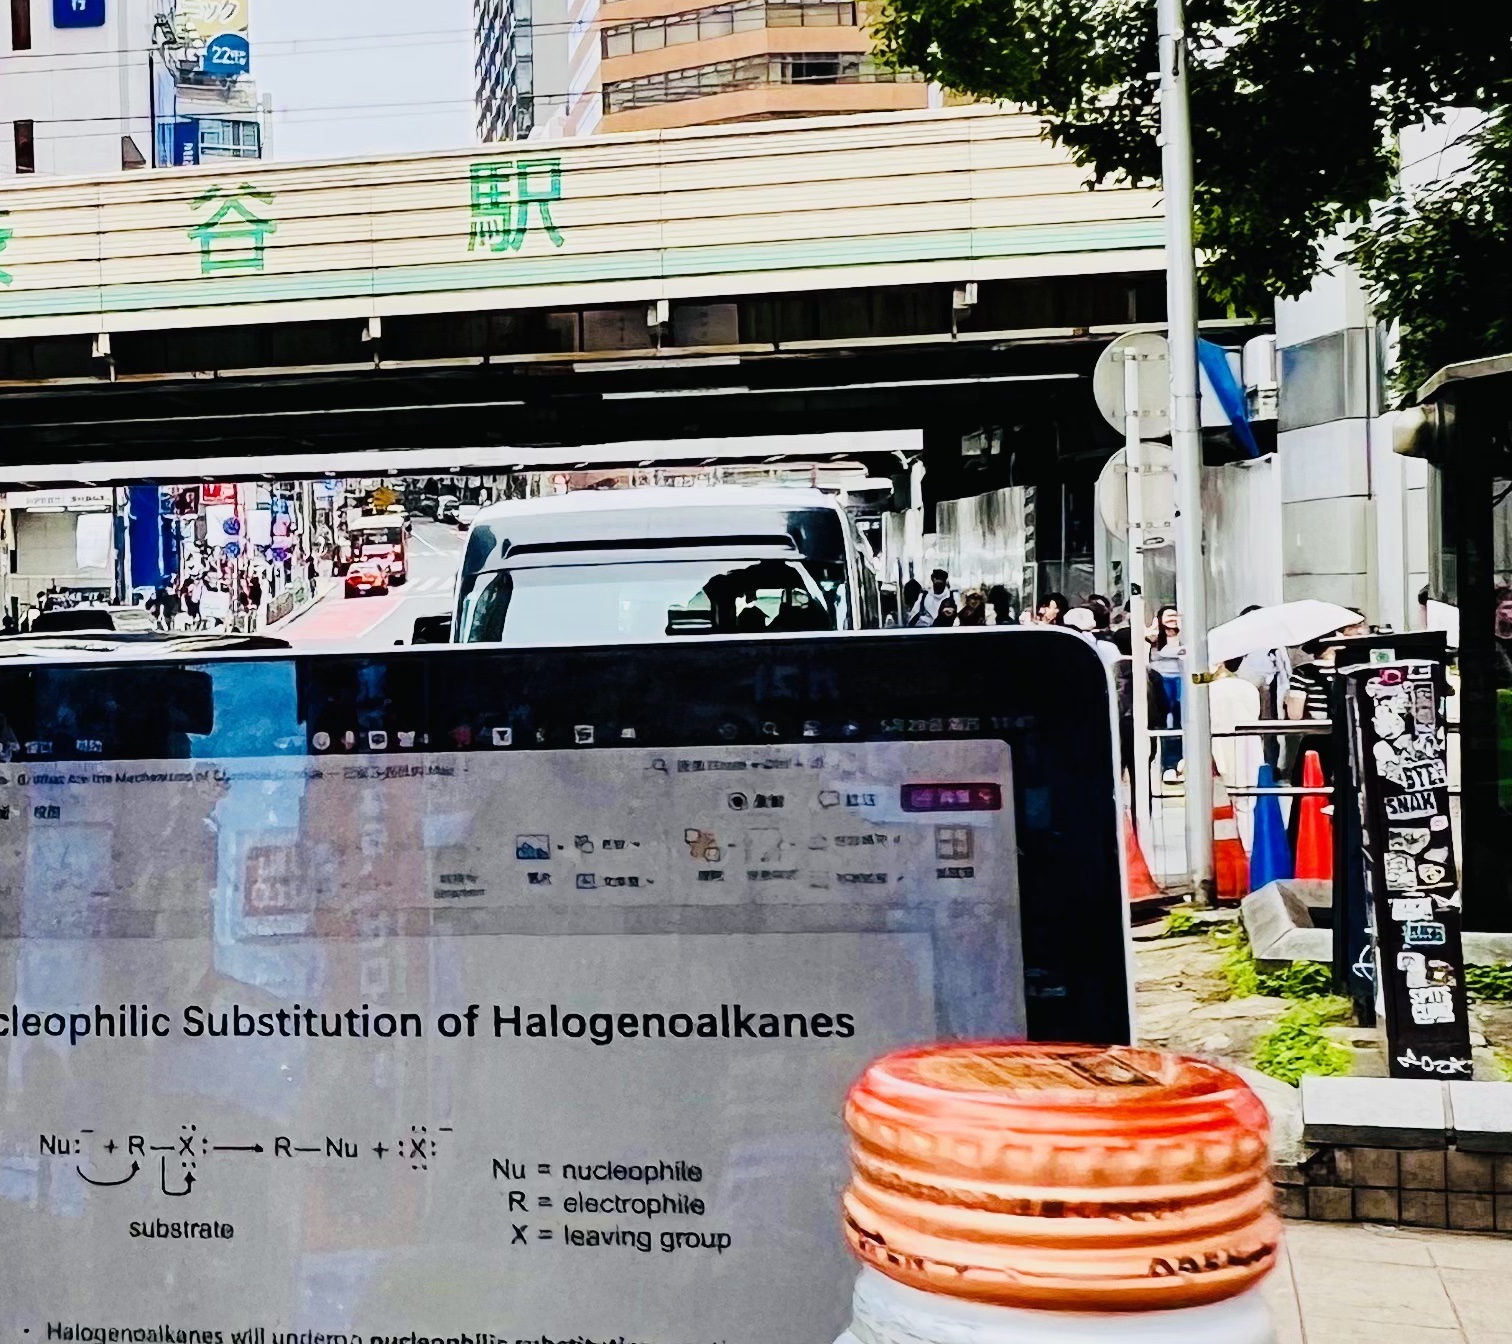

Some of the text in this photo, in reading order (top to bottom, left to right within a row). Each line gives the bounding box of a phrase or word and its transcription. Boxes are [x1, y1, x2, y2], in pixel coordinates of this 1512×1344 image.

[183, 1003, 422, 1038] Substitution
[437, 1003, 481, 1038] of
[493, 1004, 856, 1046] Halogenoalkanes
[492, 1158, 526, 1180] Nu
[562, 1159, 703, 1185] nucleophile
[508, 1190, 529, 1212] R
[563, 1191, 706, 1219] electrophile
[129, 1217, 235, 1240] substrate
[510, 1223, 529, 1245] X
[564, 1224, 652, 1252] leaving
[659, 1228, 732, 1254] group
